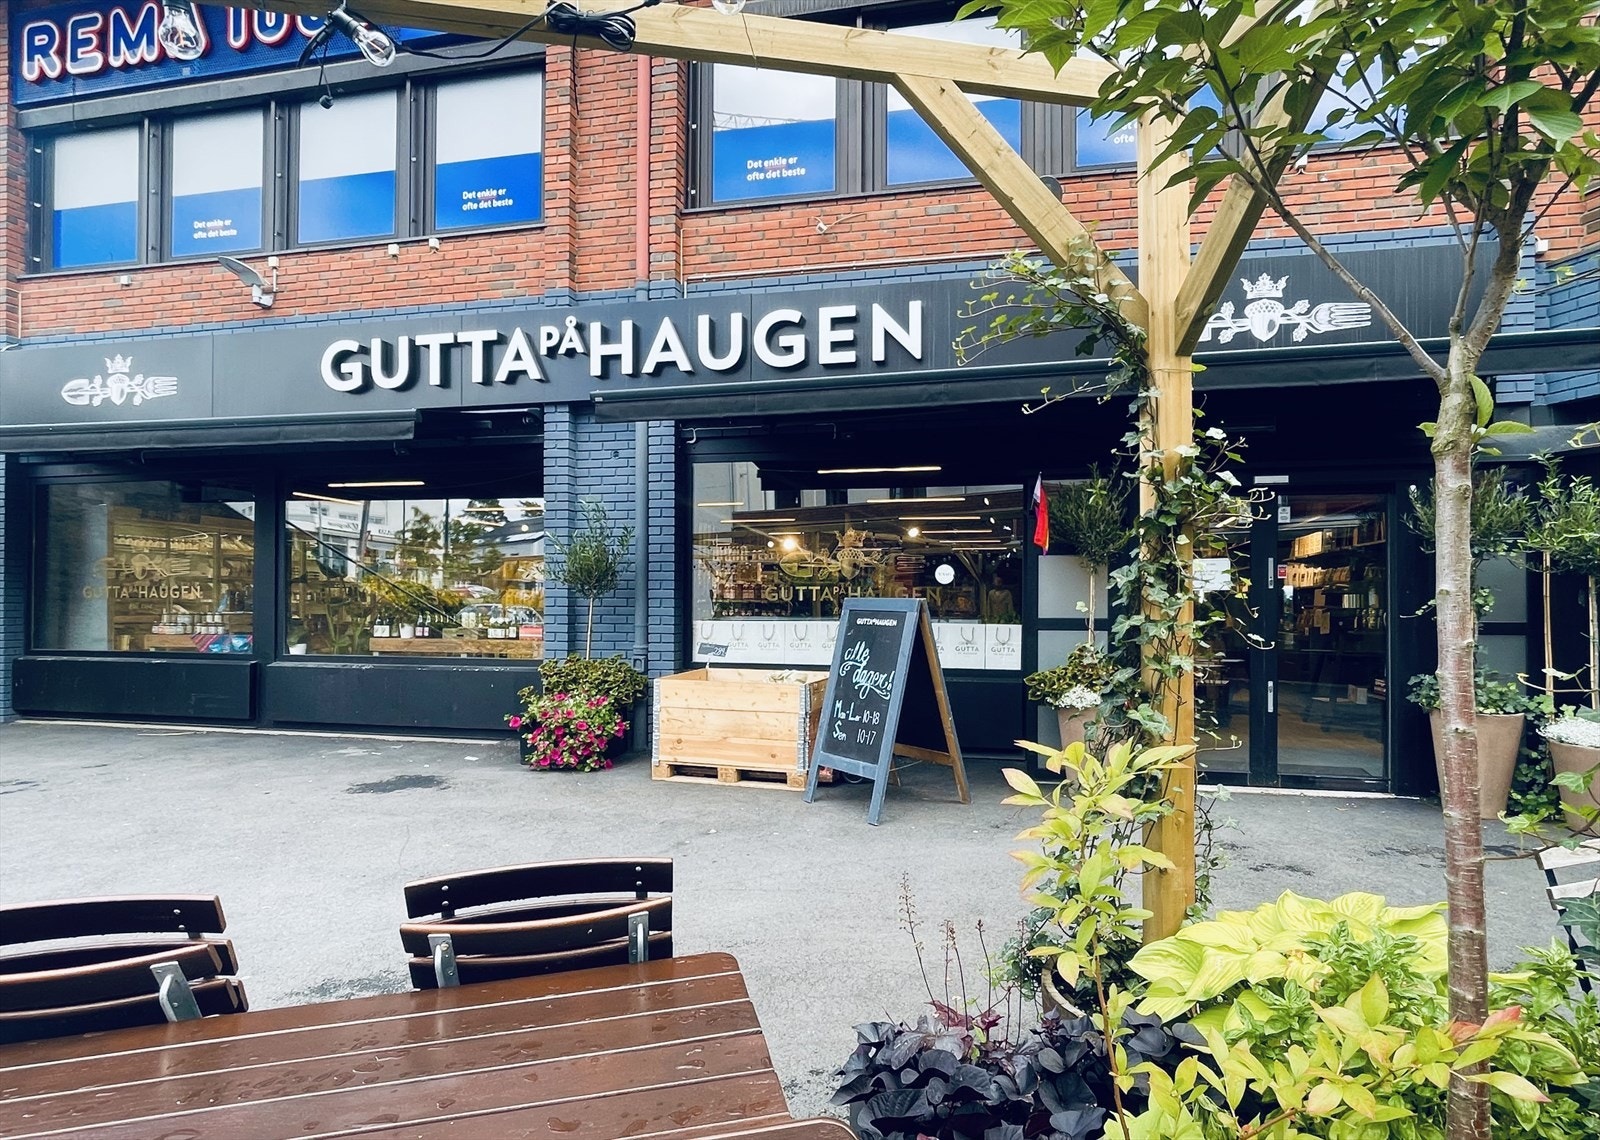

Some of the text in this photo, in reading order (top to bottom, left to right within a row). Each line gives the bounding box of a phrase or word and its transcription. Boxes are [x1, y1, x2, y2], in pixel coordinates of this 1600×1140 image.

[1113, 133, 1135, 144] ofte
[746, 156, 798, 170] Det enkle er
[746, 167, 806, 181] ofte det beste
[462, 188, 507, 200] Det enkle er
[462, 198, 514, 211] ofte det beste
[320, 300, 923, 392] GUTTA PÅ HAUGEN
[82, 585, 129, 599] GUTTA
[138, 585, 200, 600] HAUGEN
[765, 586, 834, 602] GUTTA
[862, 709, 881, 725] 10-18
[856, 728, 877, 746] 10-17
